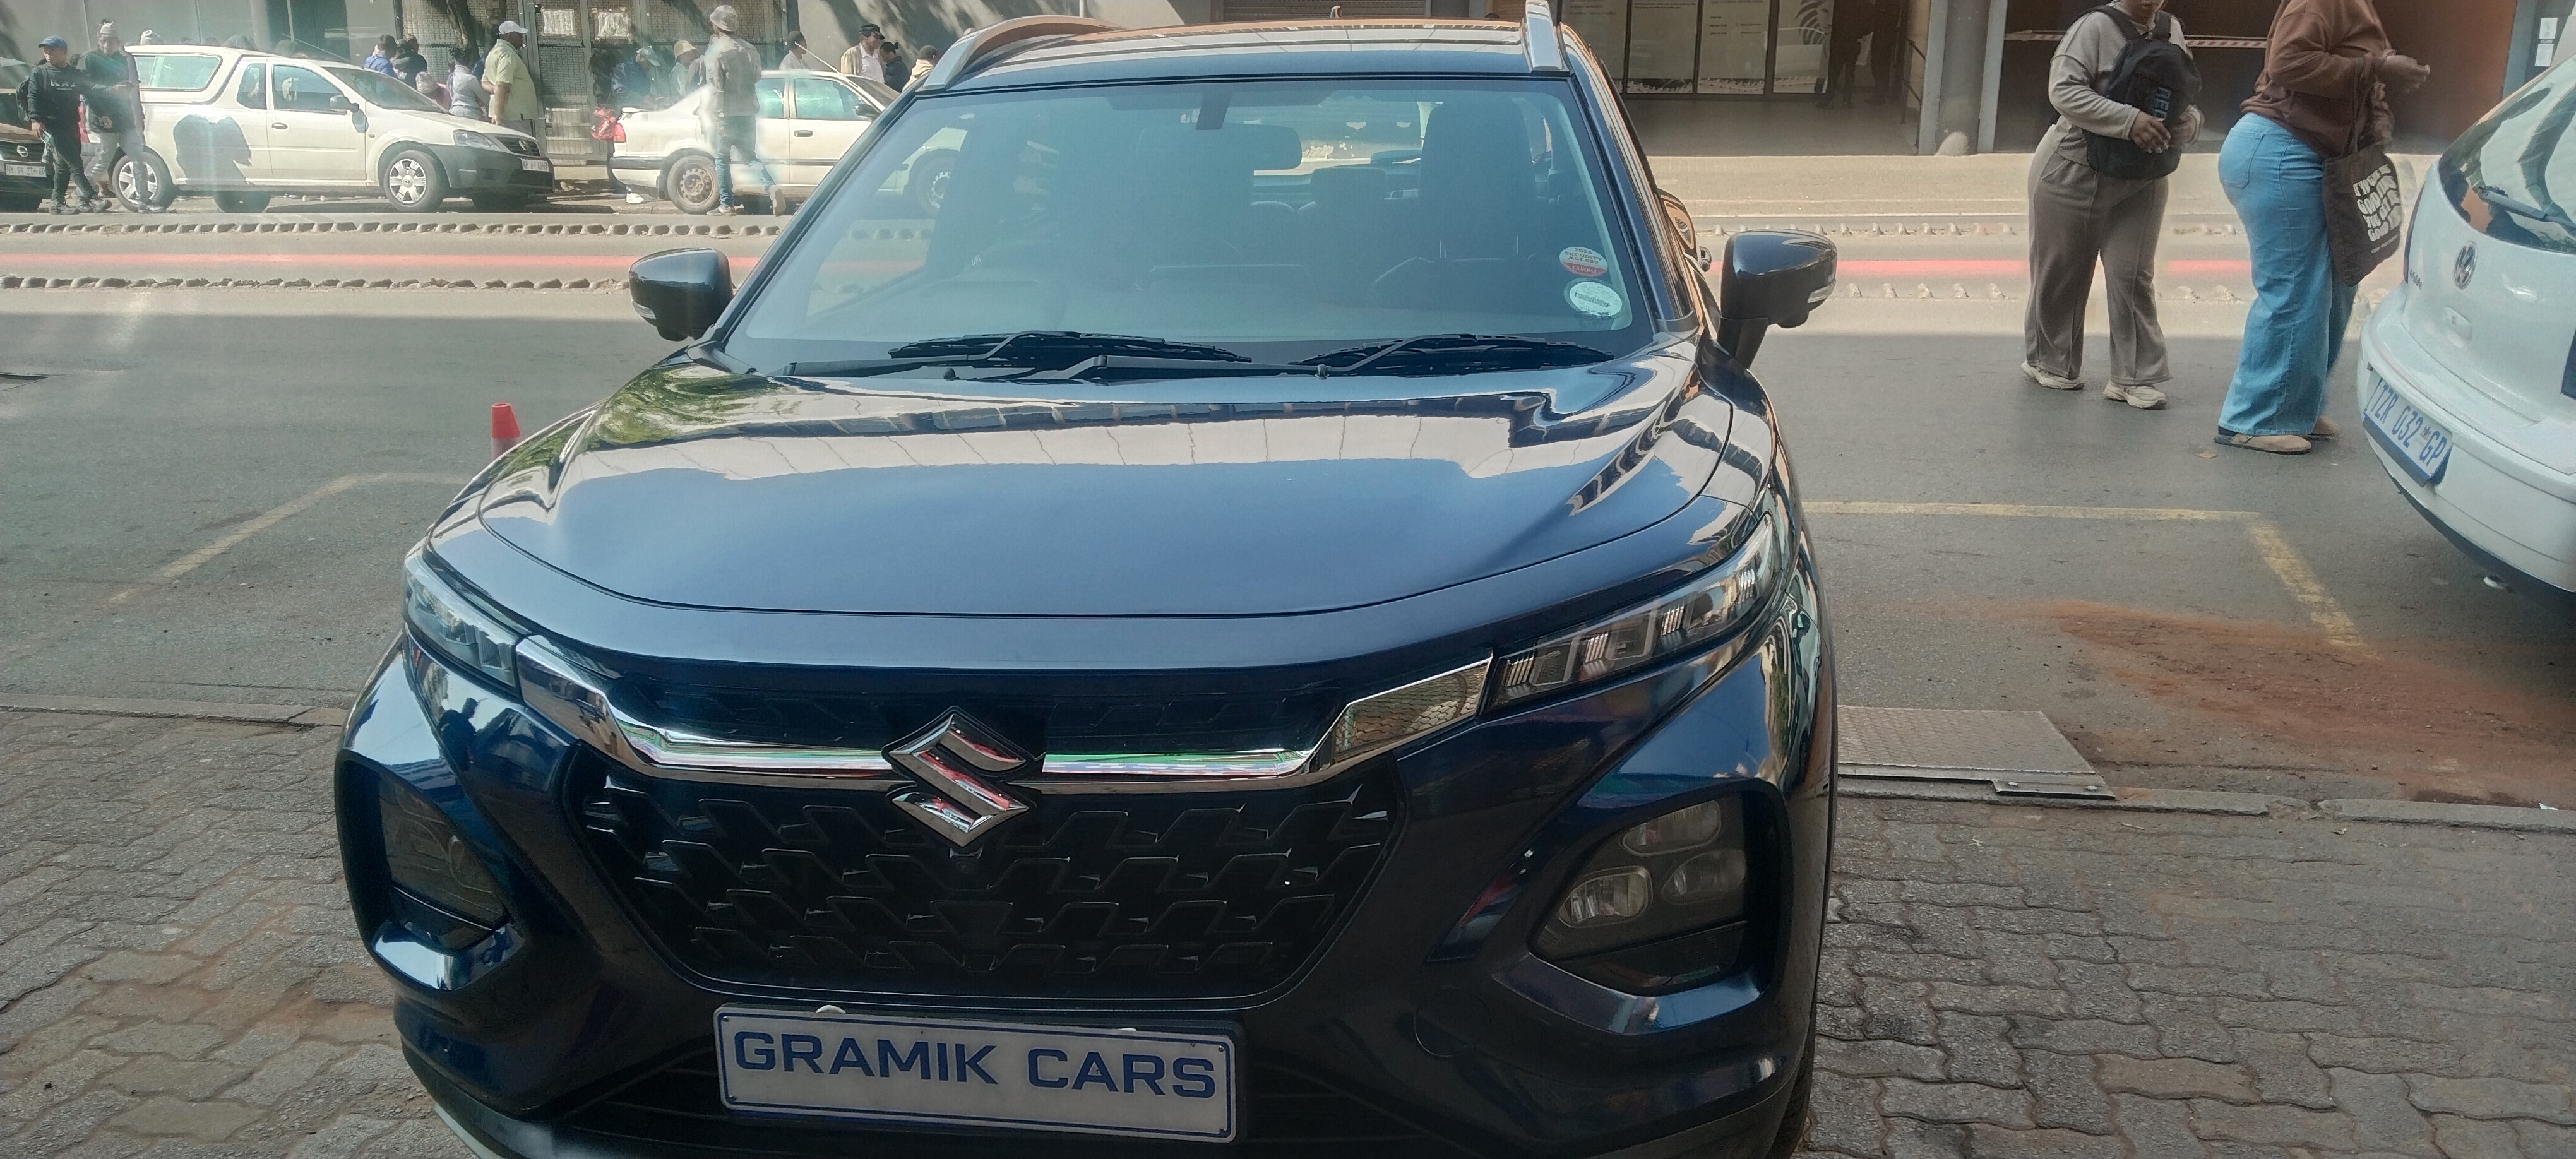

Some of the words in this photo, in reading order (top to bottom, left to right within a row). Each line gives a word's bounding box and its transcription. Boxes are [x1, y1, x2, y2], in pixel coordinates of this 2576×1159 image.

[1565, 251, 1602, 261] SECURITY
[1568, 256, 1599, 264] ACCESS
[2392, 405, 2424, 448] 032
[2419, 429, 2448, 467] GP
[734, 1031, 999, 1085] GRAMIK
[1027, 1047, 1216, 1099] CARS
